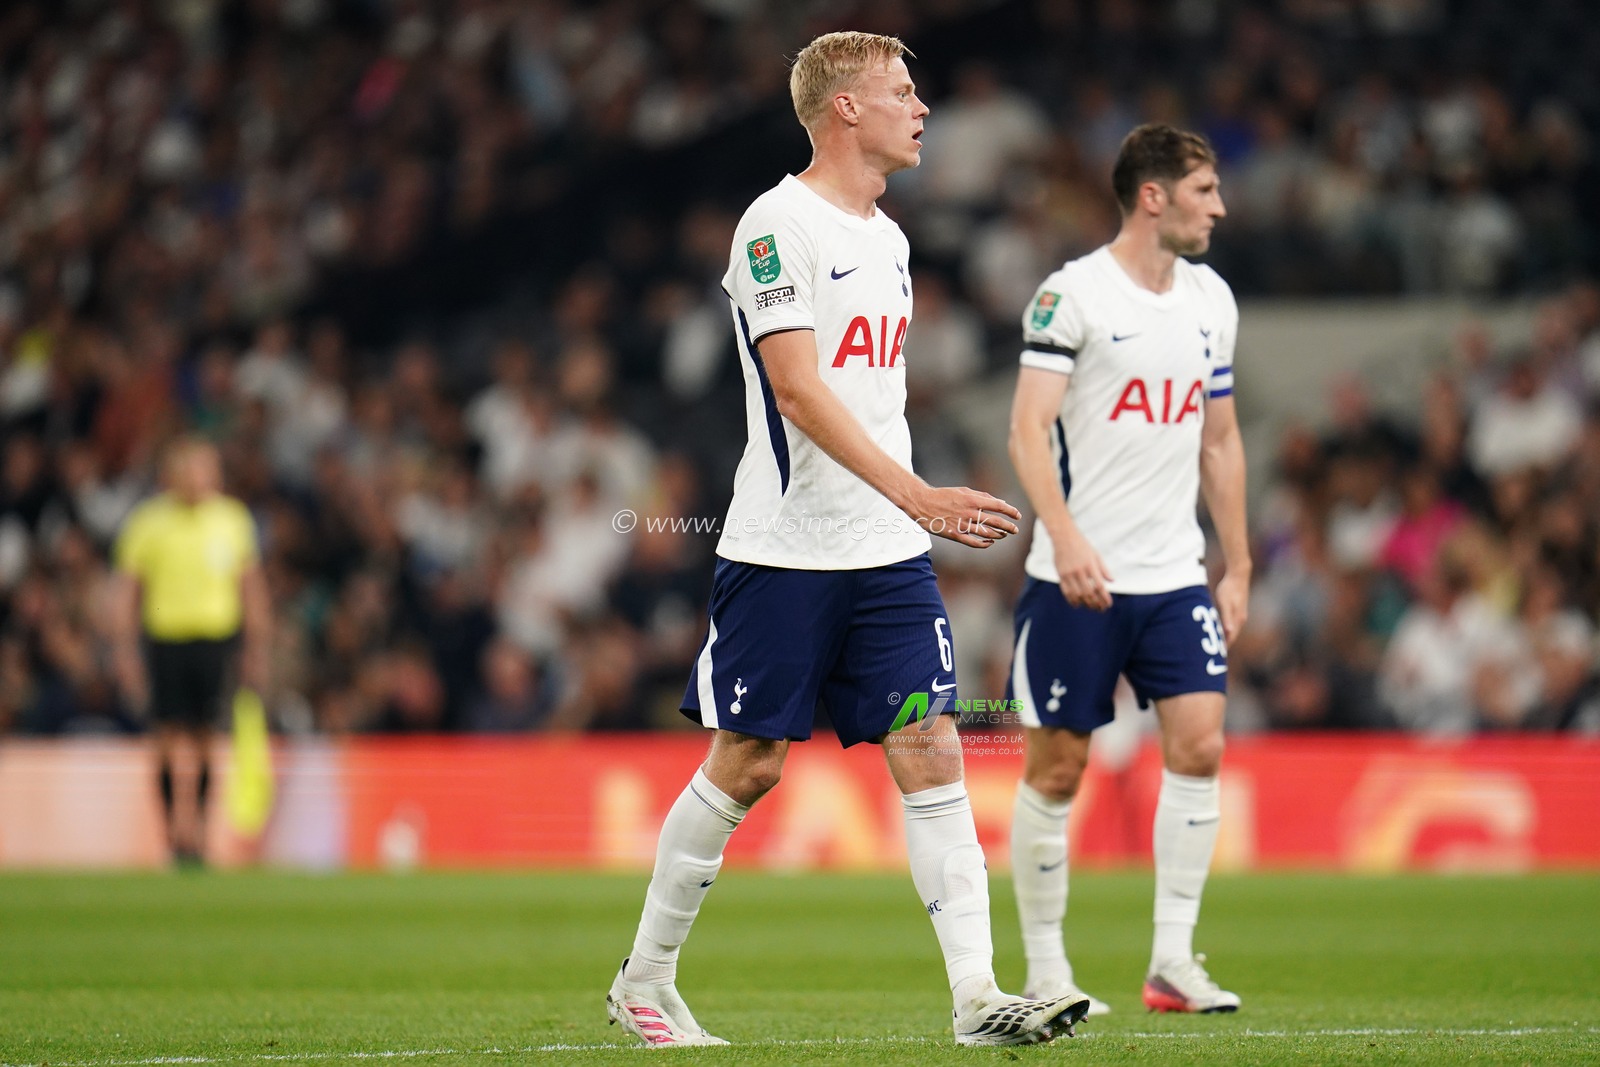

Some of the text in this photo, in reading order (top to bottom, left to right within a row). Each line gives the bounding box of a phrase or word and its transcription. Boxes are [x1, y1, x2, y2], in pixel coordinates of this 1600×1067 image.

[758, 260, 770, 269] Cup
[754, 288, 791, 302] No room
[768, 295, 795, 306] racism
[831, 315, 907, 368] AIA
[1108, 377, 1203, 424] AIA
[934, 617, 953, 672] 6
